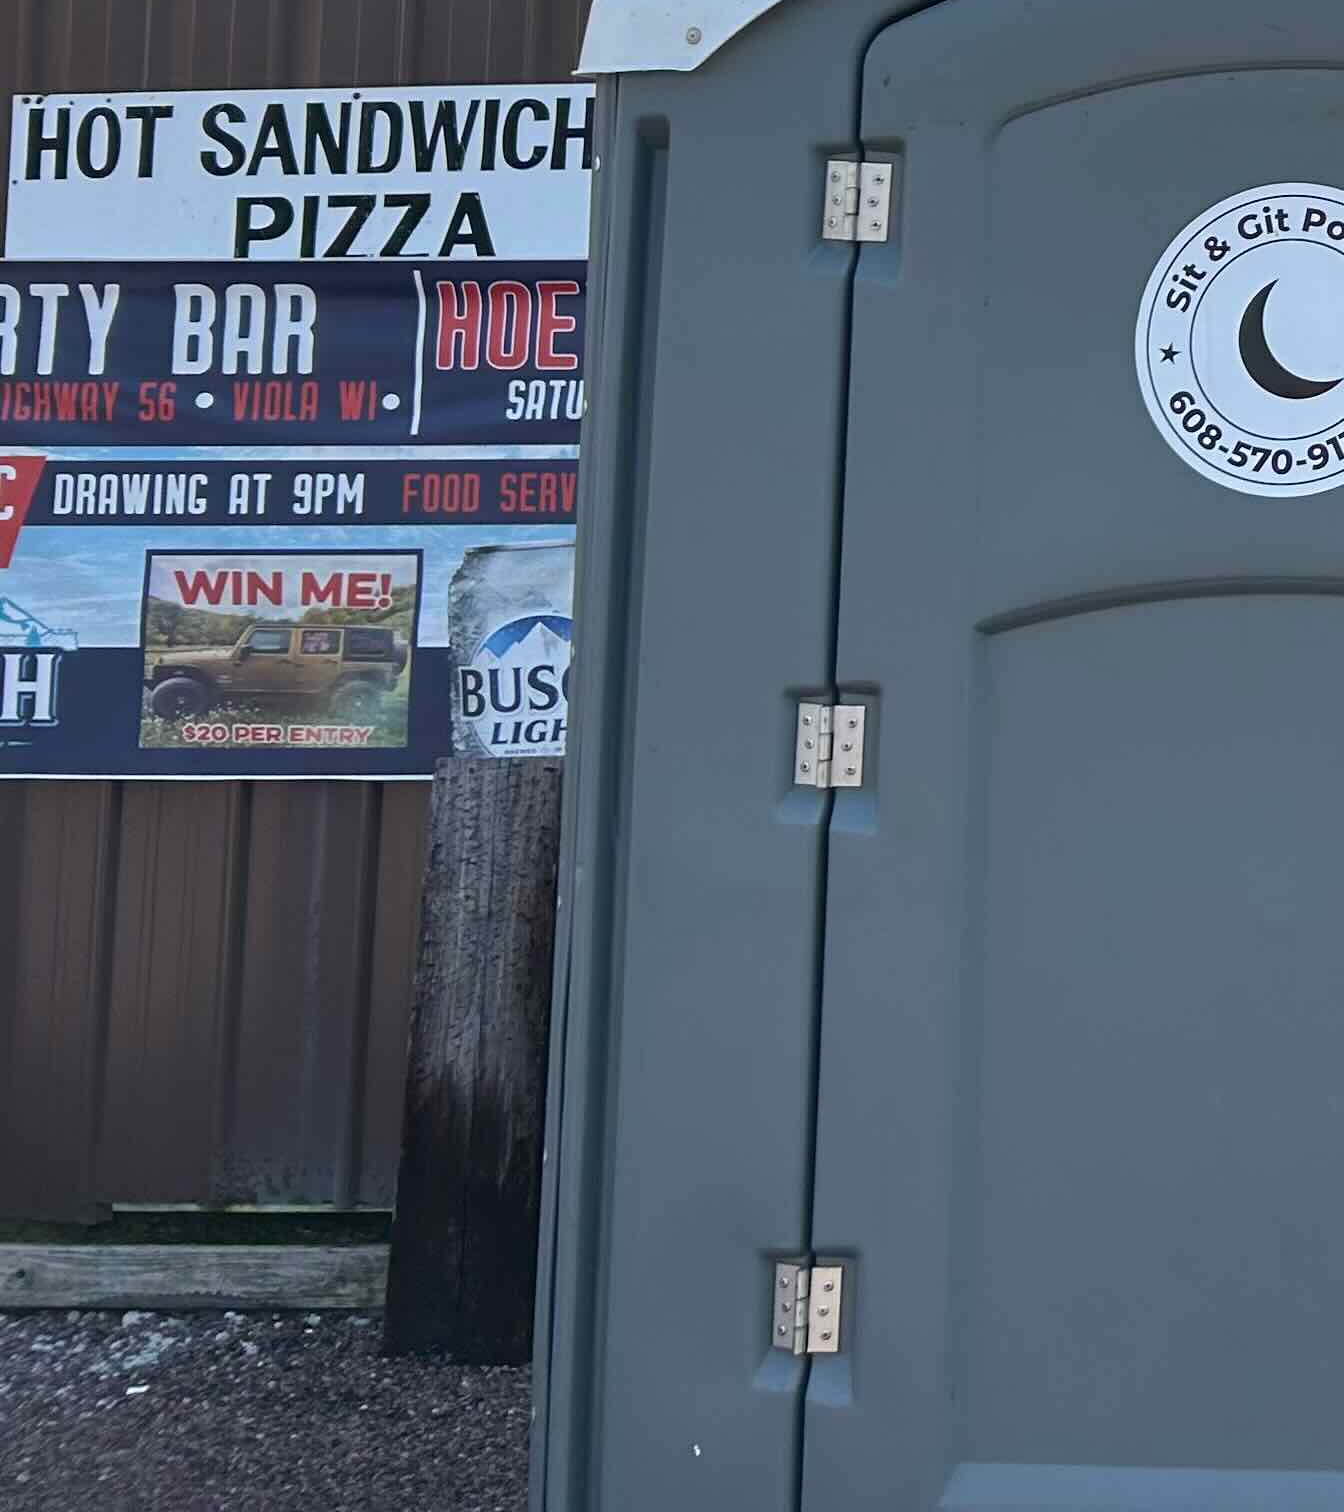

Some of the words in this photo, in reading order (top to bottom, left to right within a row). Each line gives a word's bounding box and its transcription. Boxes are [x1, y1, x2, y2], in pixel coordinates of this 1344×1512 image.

[25, 105, 173, 180] HOT
[235, 192, 496, 258] PIZZA
[1167, 263, 1206, 313] Sit
[1205, 236, 1231, 261] &
[1237, 206, 1290, 240] Git
[172, 283, 317, 375] BAR
[436, 281, 580, 370] HOE
[138, 381, 177, 422] 56
[233, 381, 319, 422] VIOLA
[339, 381, 377, 421] WI
[506, 380, 584, 420] SATU
[53, 473, 208, 515] DRAWING
[229, 474, 272, 515] AT
[293, 473, 365, 515] 9PM
[403, 473, 481, 513] FOOD
[500, 472, 577, 513] SERV
[174, 570, 283, 606] WIN
[301, 571, 393, 608] ME!
[183, 725, 227, 742] $20
[234, 726, 282, 742] PER
[288, 727, 369, 744] ENTRY
